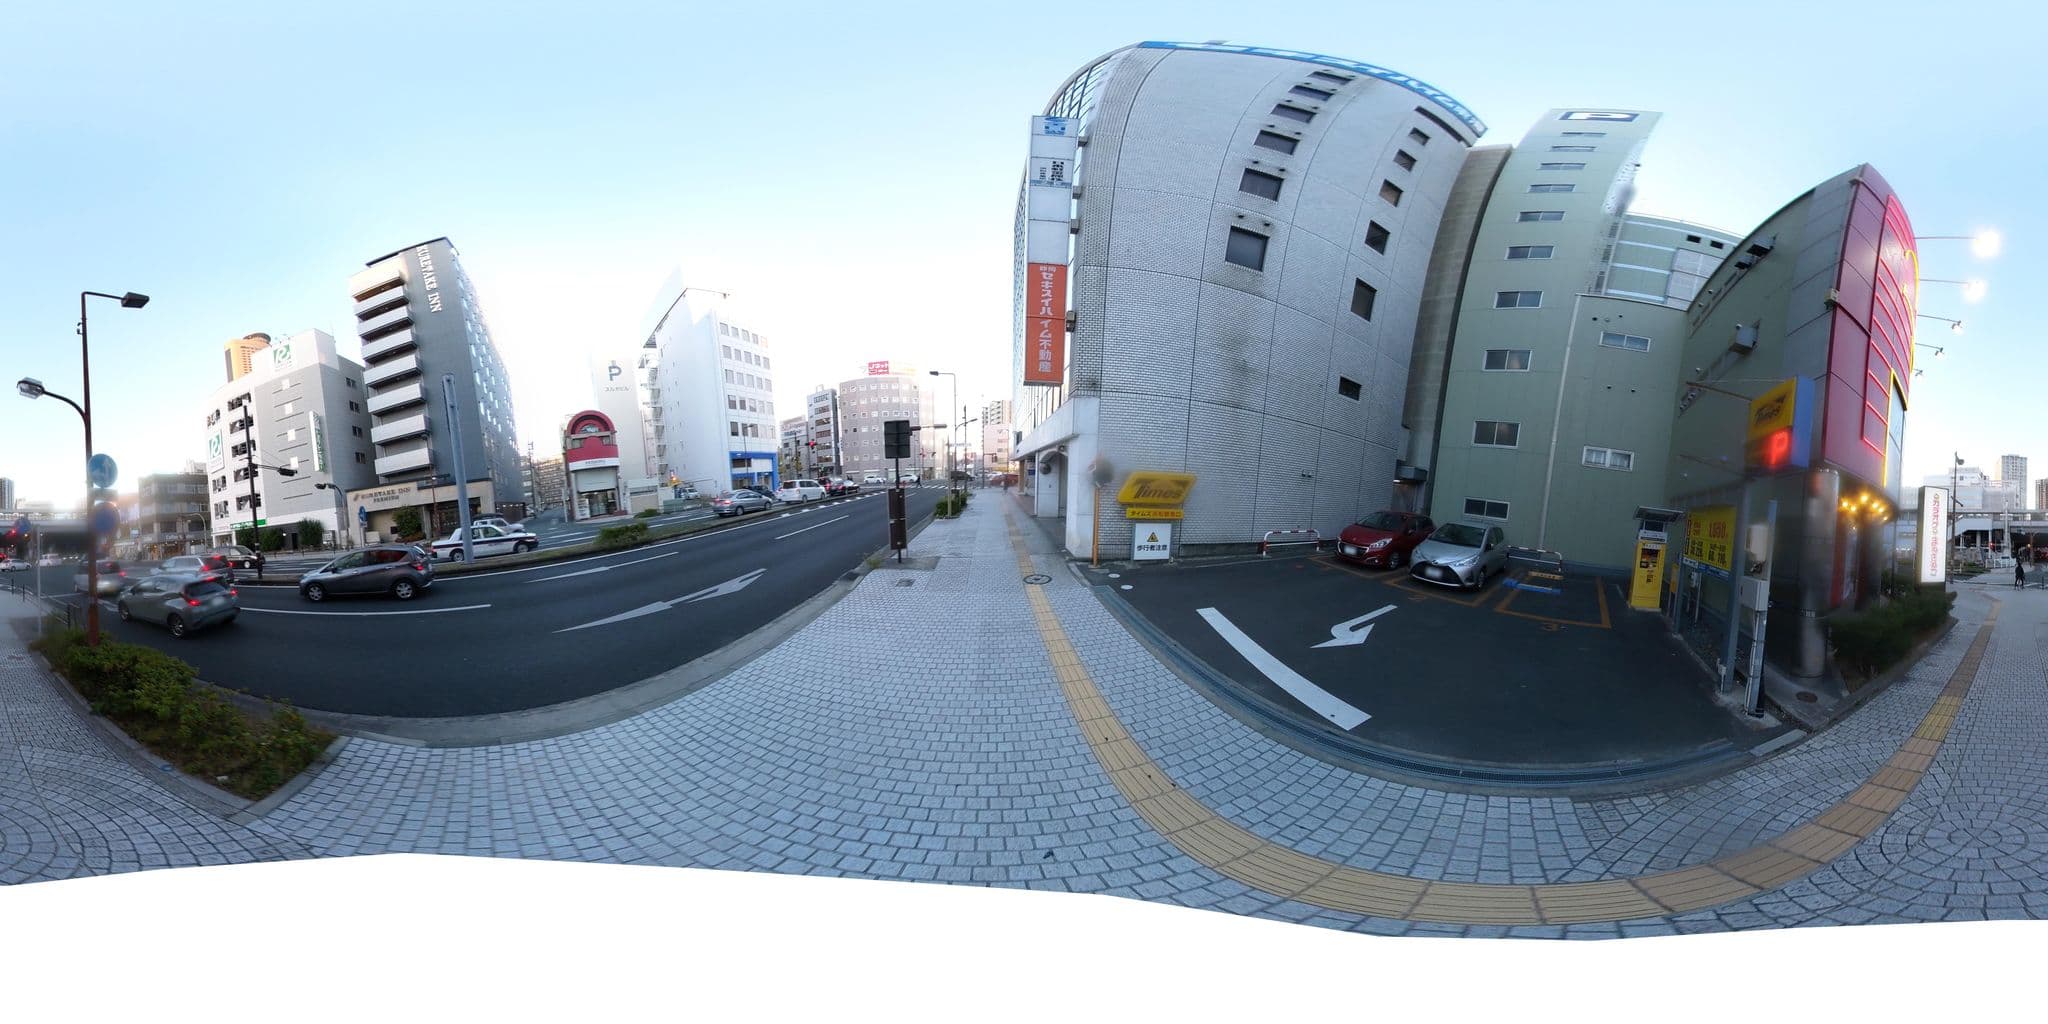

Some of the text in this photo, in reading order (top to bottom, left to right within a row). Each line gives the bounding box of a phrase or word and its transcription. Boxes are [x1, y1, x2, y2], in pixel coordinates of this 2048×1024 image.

[416, 245, 443, 313] KURETAKE INN
[1038, 271, 1054, 373] セキスイハイム不動産
[1770, 431, 1789, 466] P
